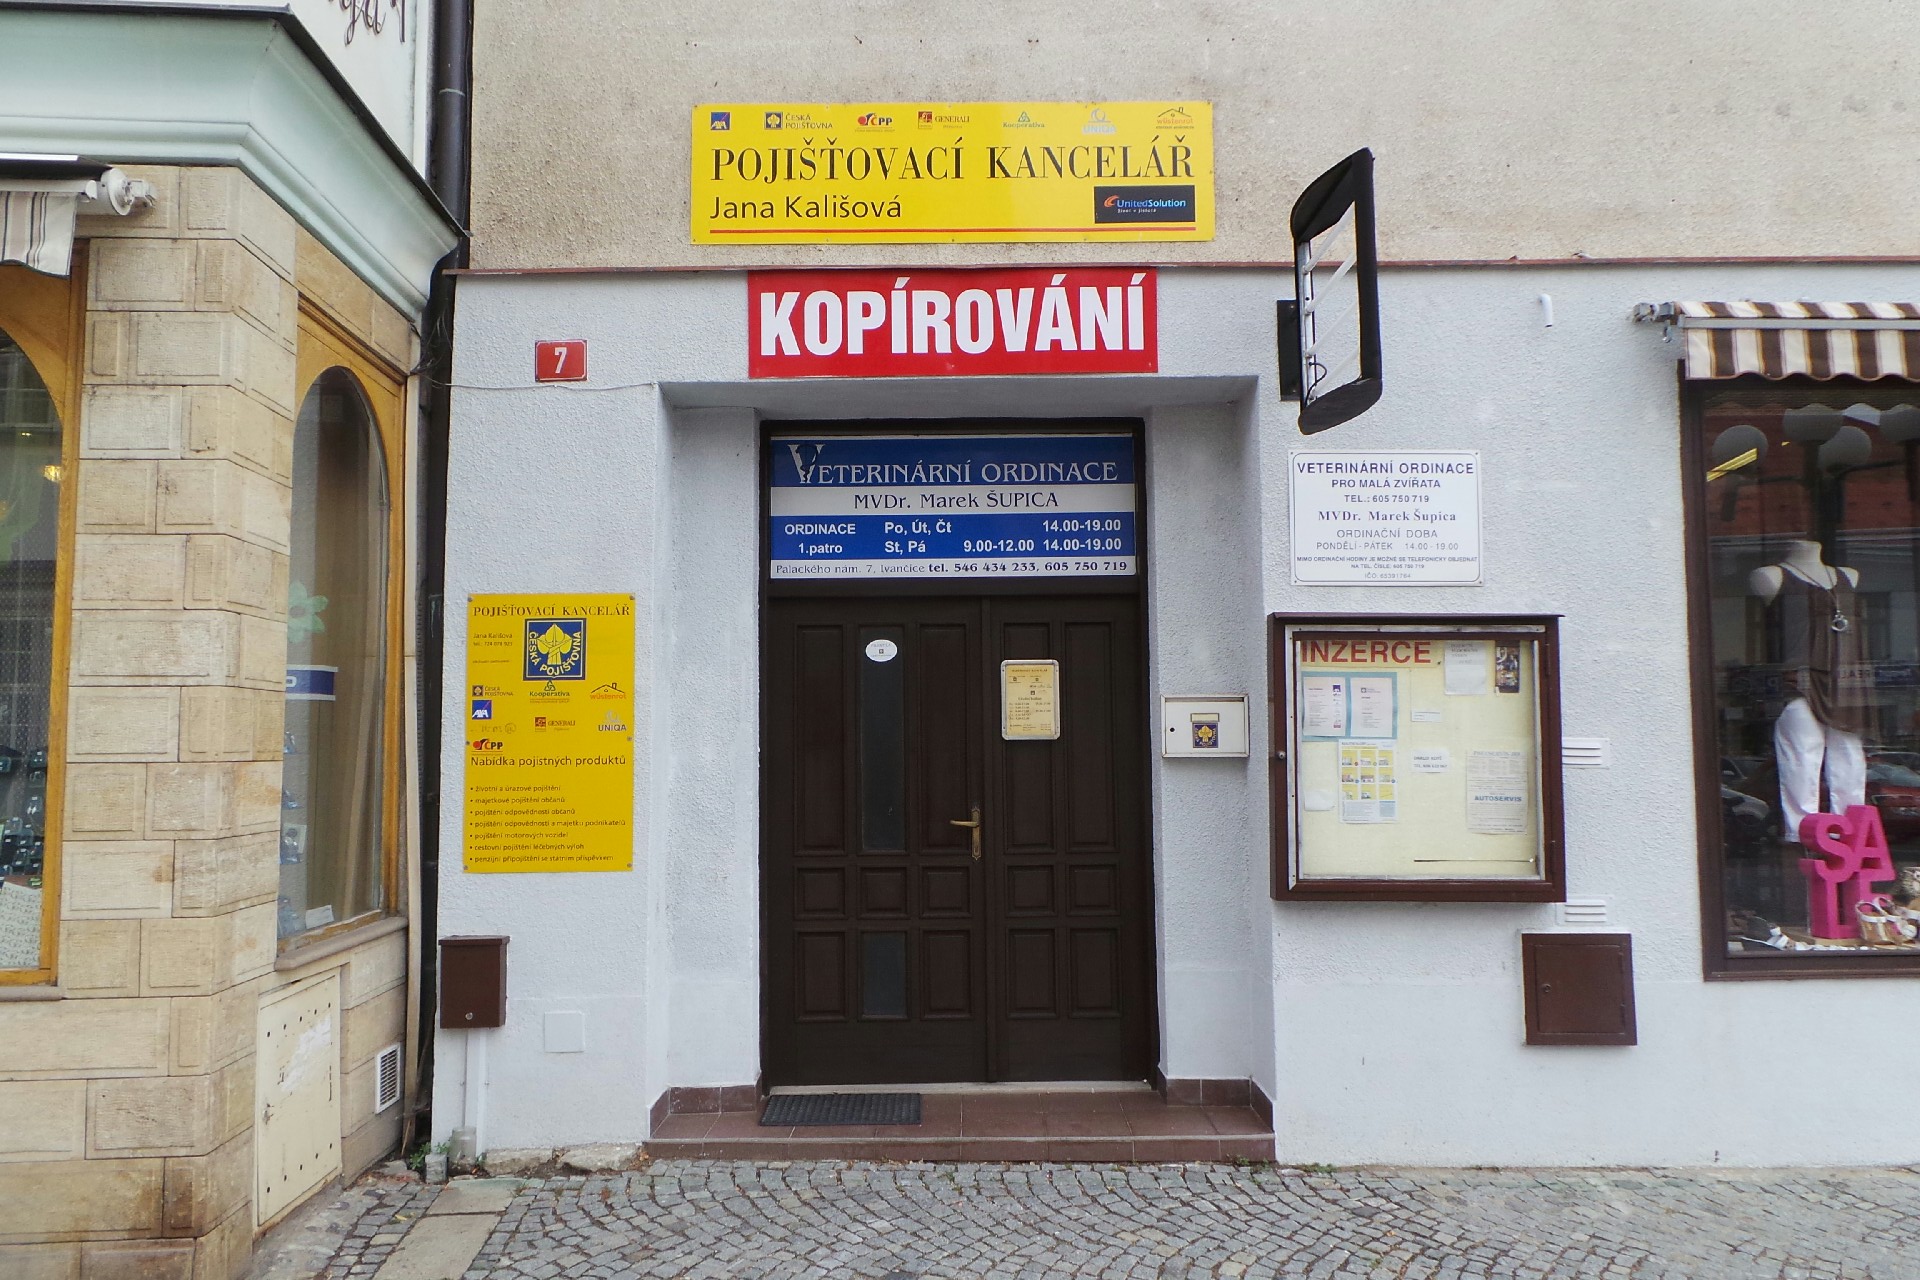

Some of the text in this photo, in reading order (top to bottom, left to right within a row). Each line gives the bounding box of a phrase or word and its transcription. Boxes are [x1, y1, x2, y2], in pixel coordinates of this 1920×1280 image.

[785, 112, 811, 121] ČESKÁ
[935, 115, 970, 123] GENERALI
[1002, 121, 1045, 129] Kooperativa
[710, 134, 1195, 184] POJIŠŤOVACÍ KANCELÁŘ
[710, 194, 902, 219] Jana Kališová
[1116, 198, 1187, 208] UnitedSolution
[760, 272, 1147, 357] KOPÍROVÁNÍ
[554, 346, 567, 374] 7
[787, 443, 1119, 484] VETERINÁRNÍ ORDINACE
[1297, 460, 1475, 474] VETERINÁRNÍ ORDINACE
[1331, 477, 1441, 488] PRO MALÁ ZVÍŘATA
[853, 489, 1059, 510] MVDr. Marek ŠUPICA
[1372, 495, 1390, 503] 605
[1392, 495, 1410, 503] 750
[1412, 495, 1430, 503] 719
[1318, 508, 1456, 524] MVDr. Marek Šupica
[784, 519, 1122, 537] ORDINACE Po, Út, Čt 14.00-19.00
[1336, 527, 1438, 538] ORDINAČNÍ DOBA
[798, 538, 1123, 556] 1.patro St, Pá 9.00-12.00 14.00-19.00
[776, 561, 1128, 576] Palackého nám. 7, Ivančice tel. 546 434 233, 605 750 719
[473, 603, 630, 617] POJIŠŤOVACÍ KANCELÁŘ
[529, 631, 582, 676] ČESKÁ POJIŠŤOVNA
[1301, 640, 1431, 663] INZERCE
[472, 709, 489, 718] AXA
[598, 724, 627, 732] UNIQA
[484, 739, 504, 750] ČPP
[471, 755, 626, 767] Nabídka pojistných produktů
[1474, 795, 1522, 803] AUTOSERVIS
